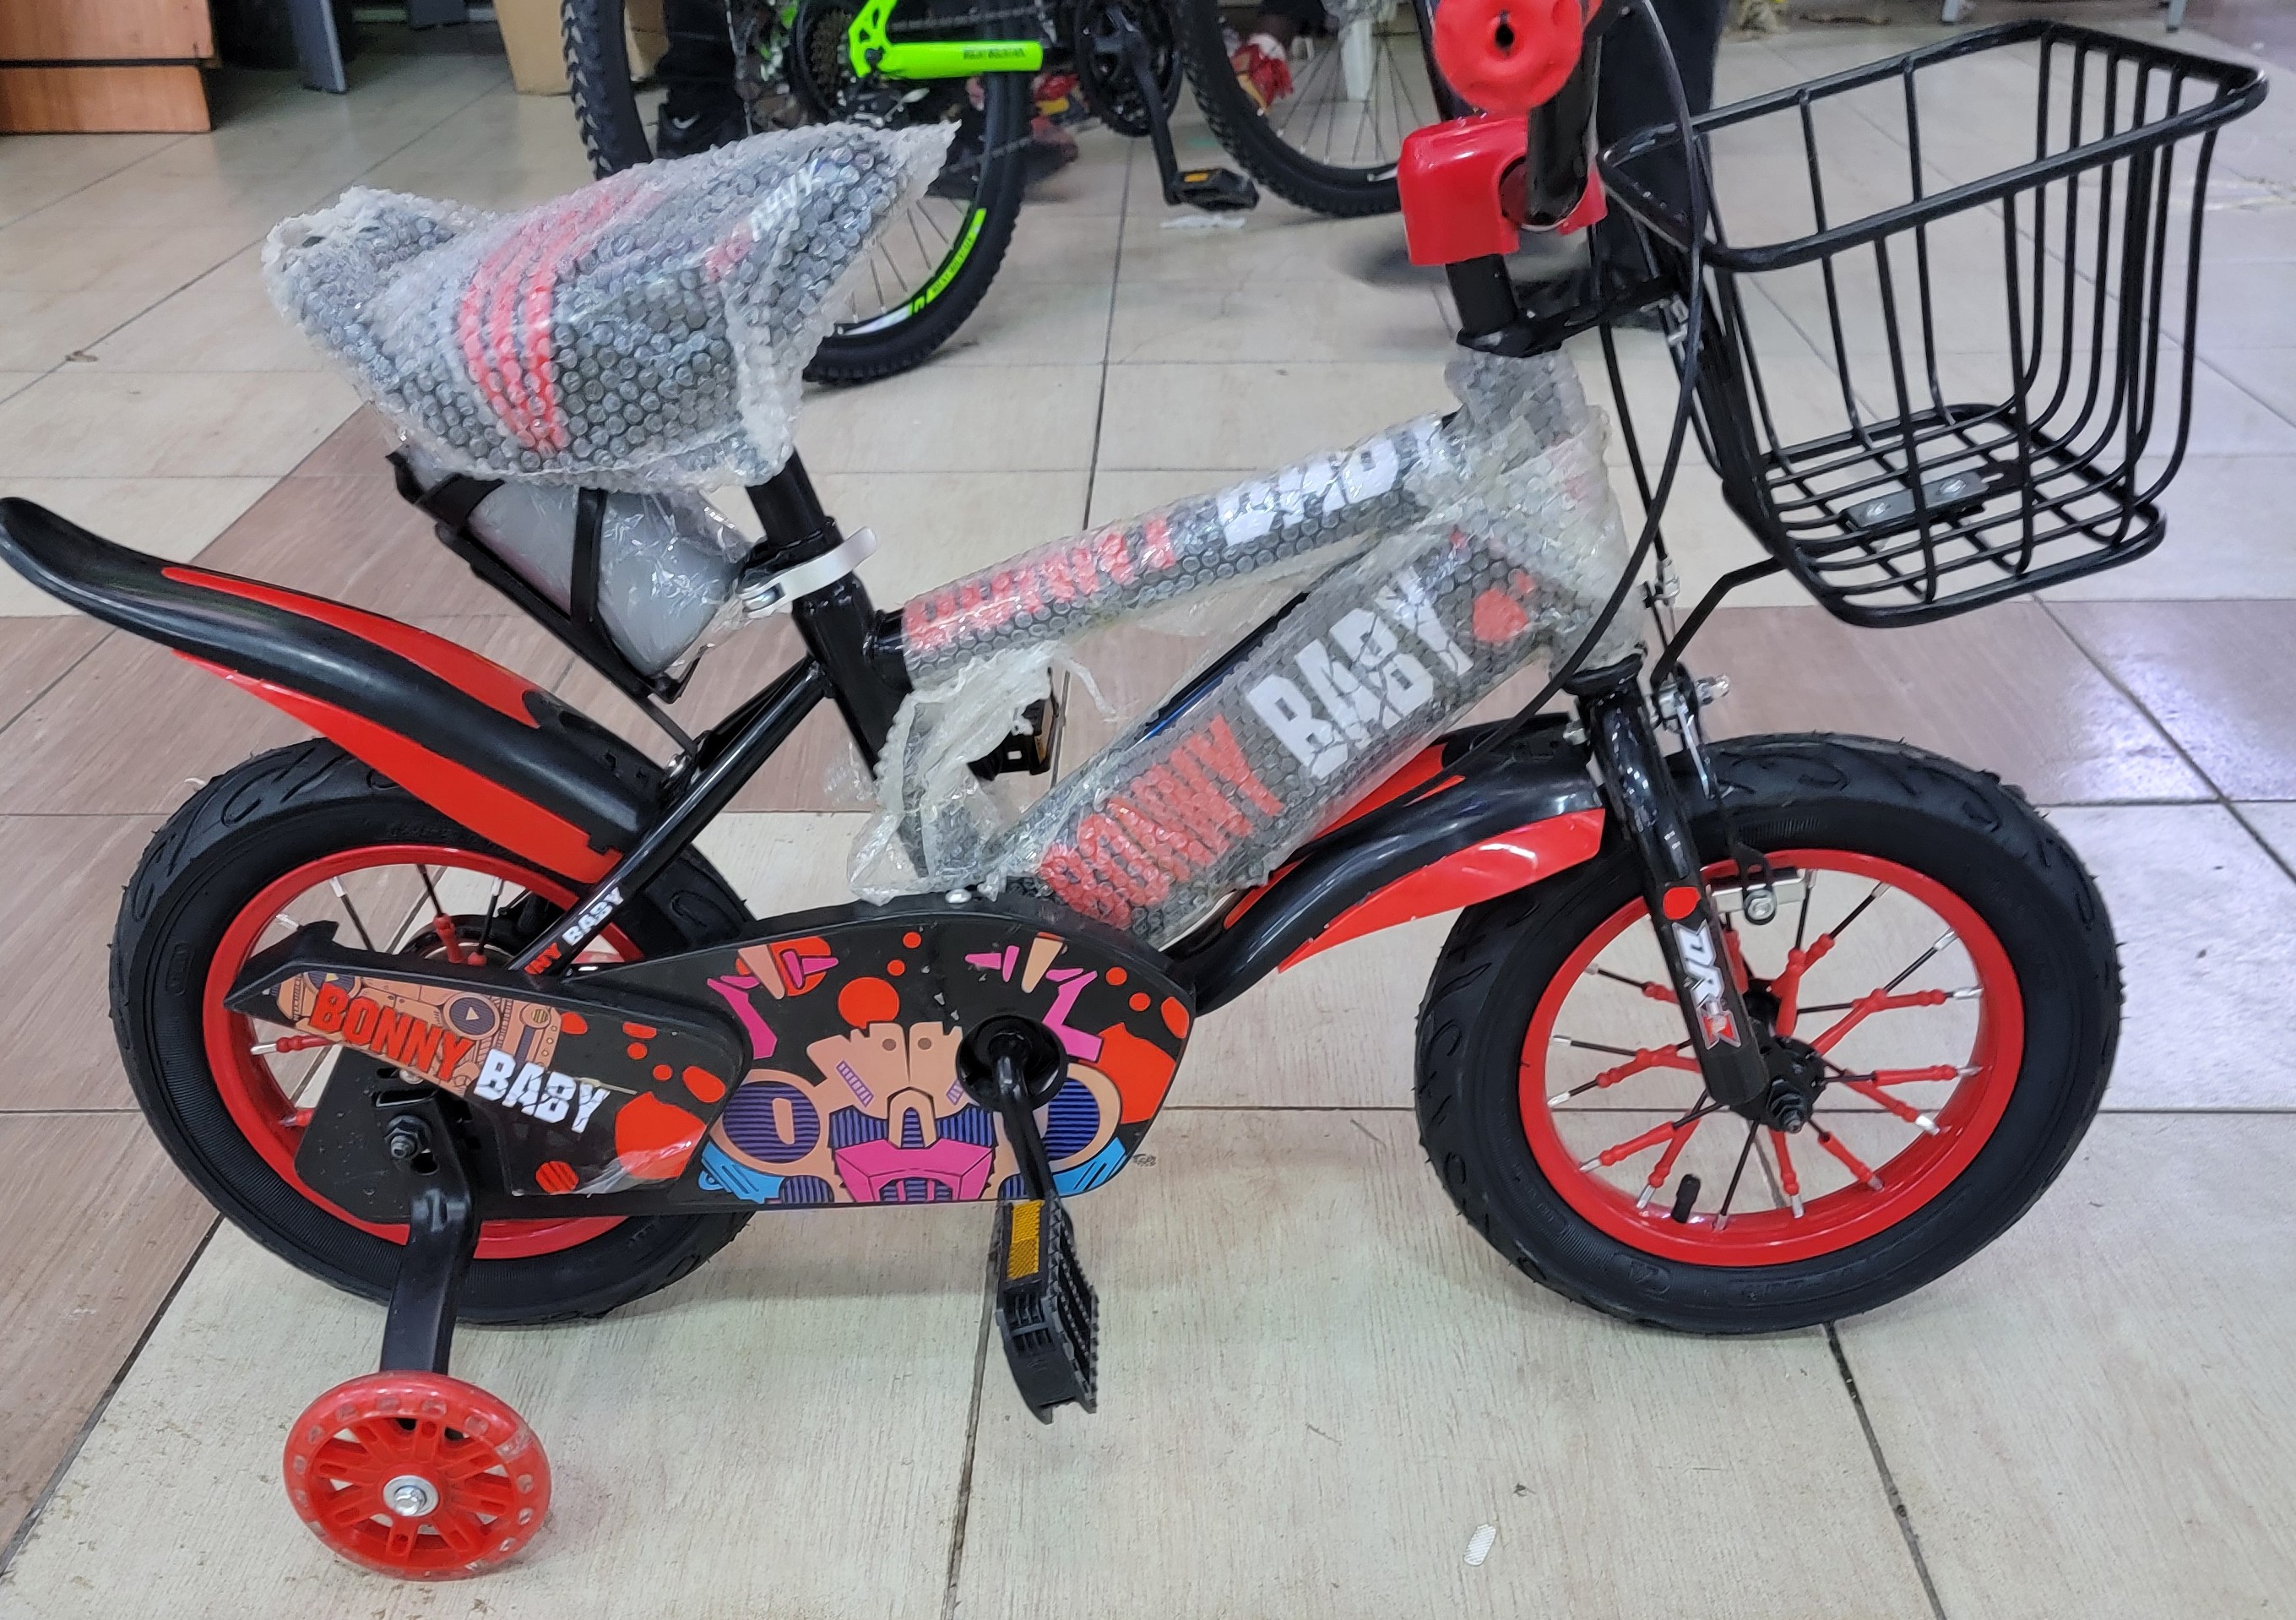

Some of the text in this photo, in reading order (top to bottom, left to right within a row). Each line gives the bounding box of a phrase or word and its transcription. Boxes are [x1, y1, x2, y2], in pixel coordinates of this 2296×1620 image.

[1039, 565, 1474, 929] BONNY BABY
[562, 886, 625, 947] BABY
[309, 981, 611, 1134] BONNY BABY
